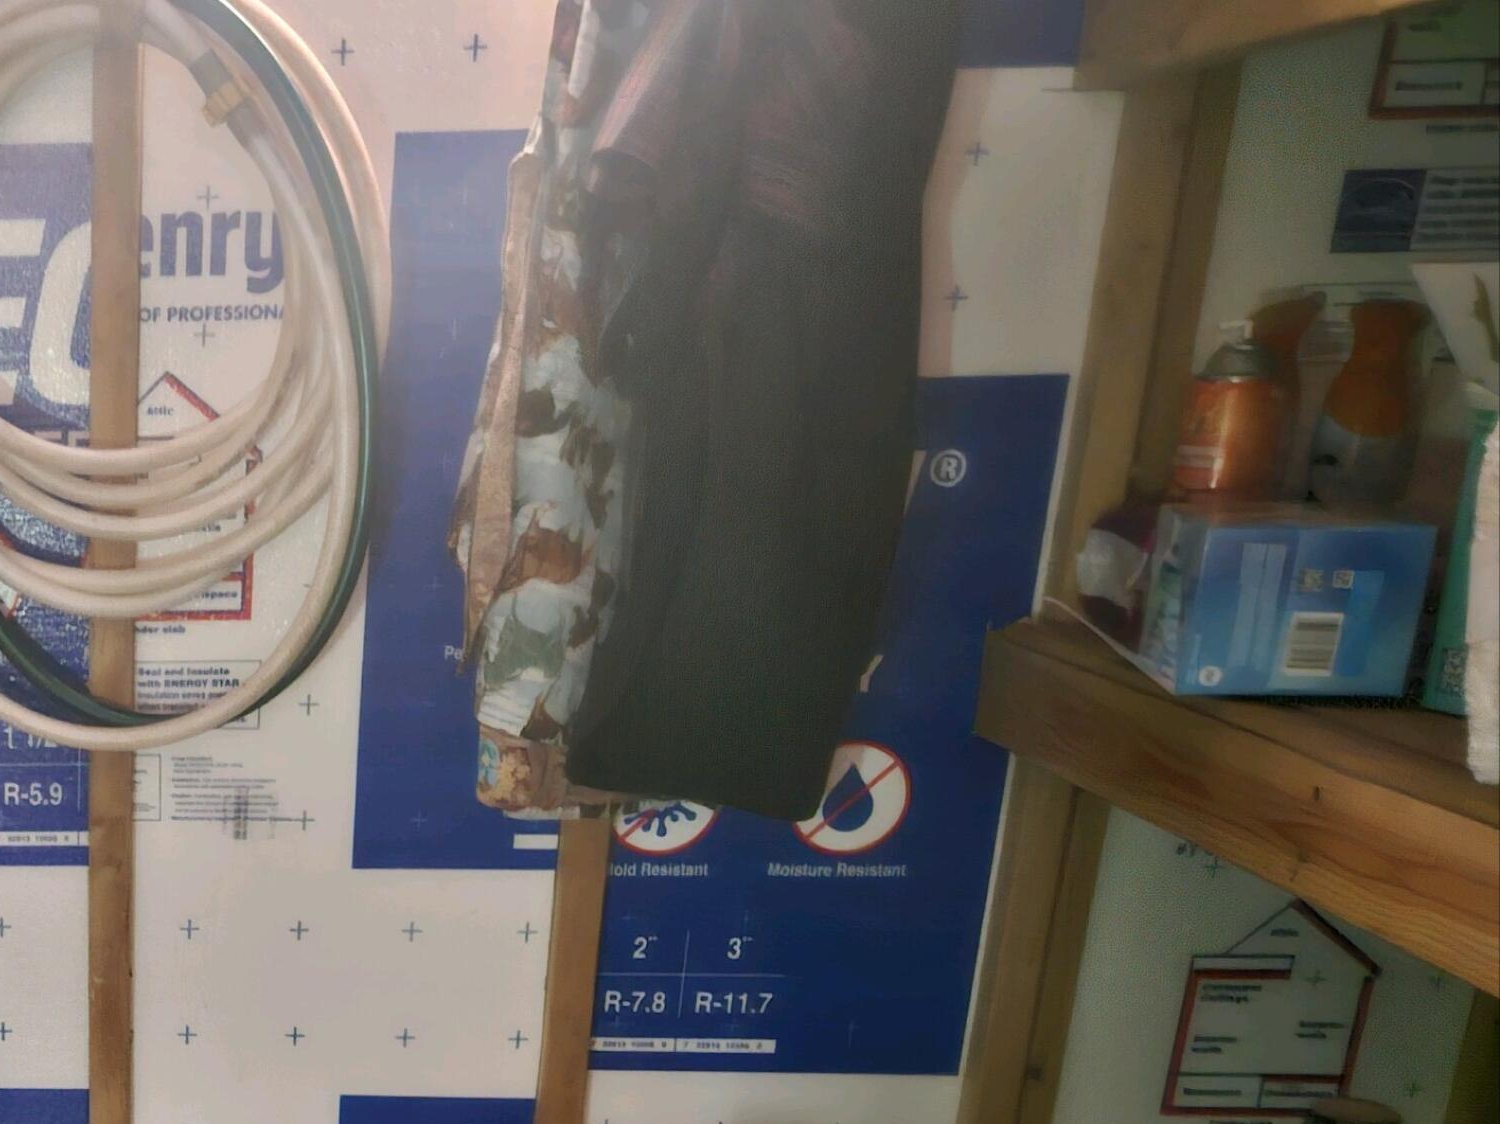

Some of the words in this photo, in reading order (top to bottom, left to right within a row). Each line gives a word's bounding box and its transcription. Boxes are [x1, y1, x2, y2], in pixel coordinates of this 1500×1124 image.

[167, 304, 283, 322] PROFESSION
[4, 783, 62, 806] R-5.9
[641, 862, 709, 877] Resistant
[767, 862, 832, 877] Moisture
[837, 863, 907, 877] Resistant
[604, 990, 666, 1013] R-7.8
[694, 992, 773, 1014] R-11.7
